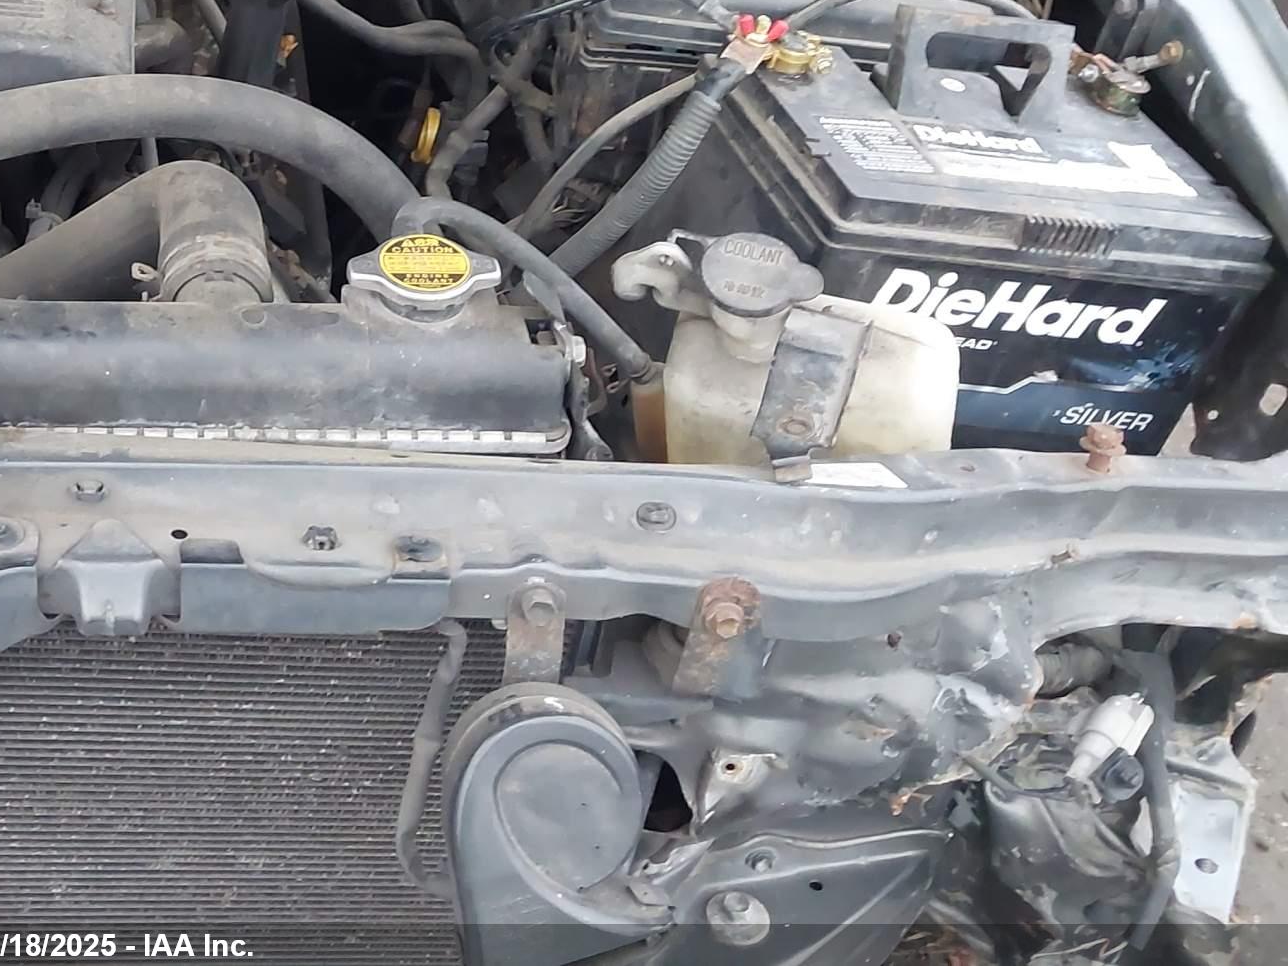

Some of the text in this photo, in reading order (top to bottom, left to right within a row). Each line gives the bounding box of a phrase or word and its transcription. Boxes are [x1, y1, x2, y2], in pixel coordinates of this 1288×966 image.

[912, 124, 1044, 153] DieHard
[724, 239, 784, 266] COOLANT
[871, 267, 1168, 346] DieHard
[1059, 406, 1154, 432] SILVER
